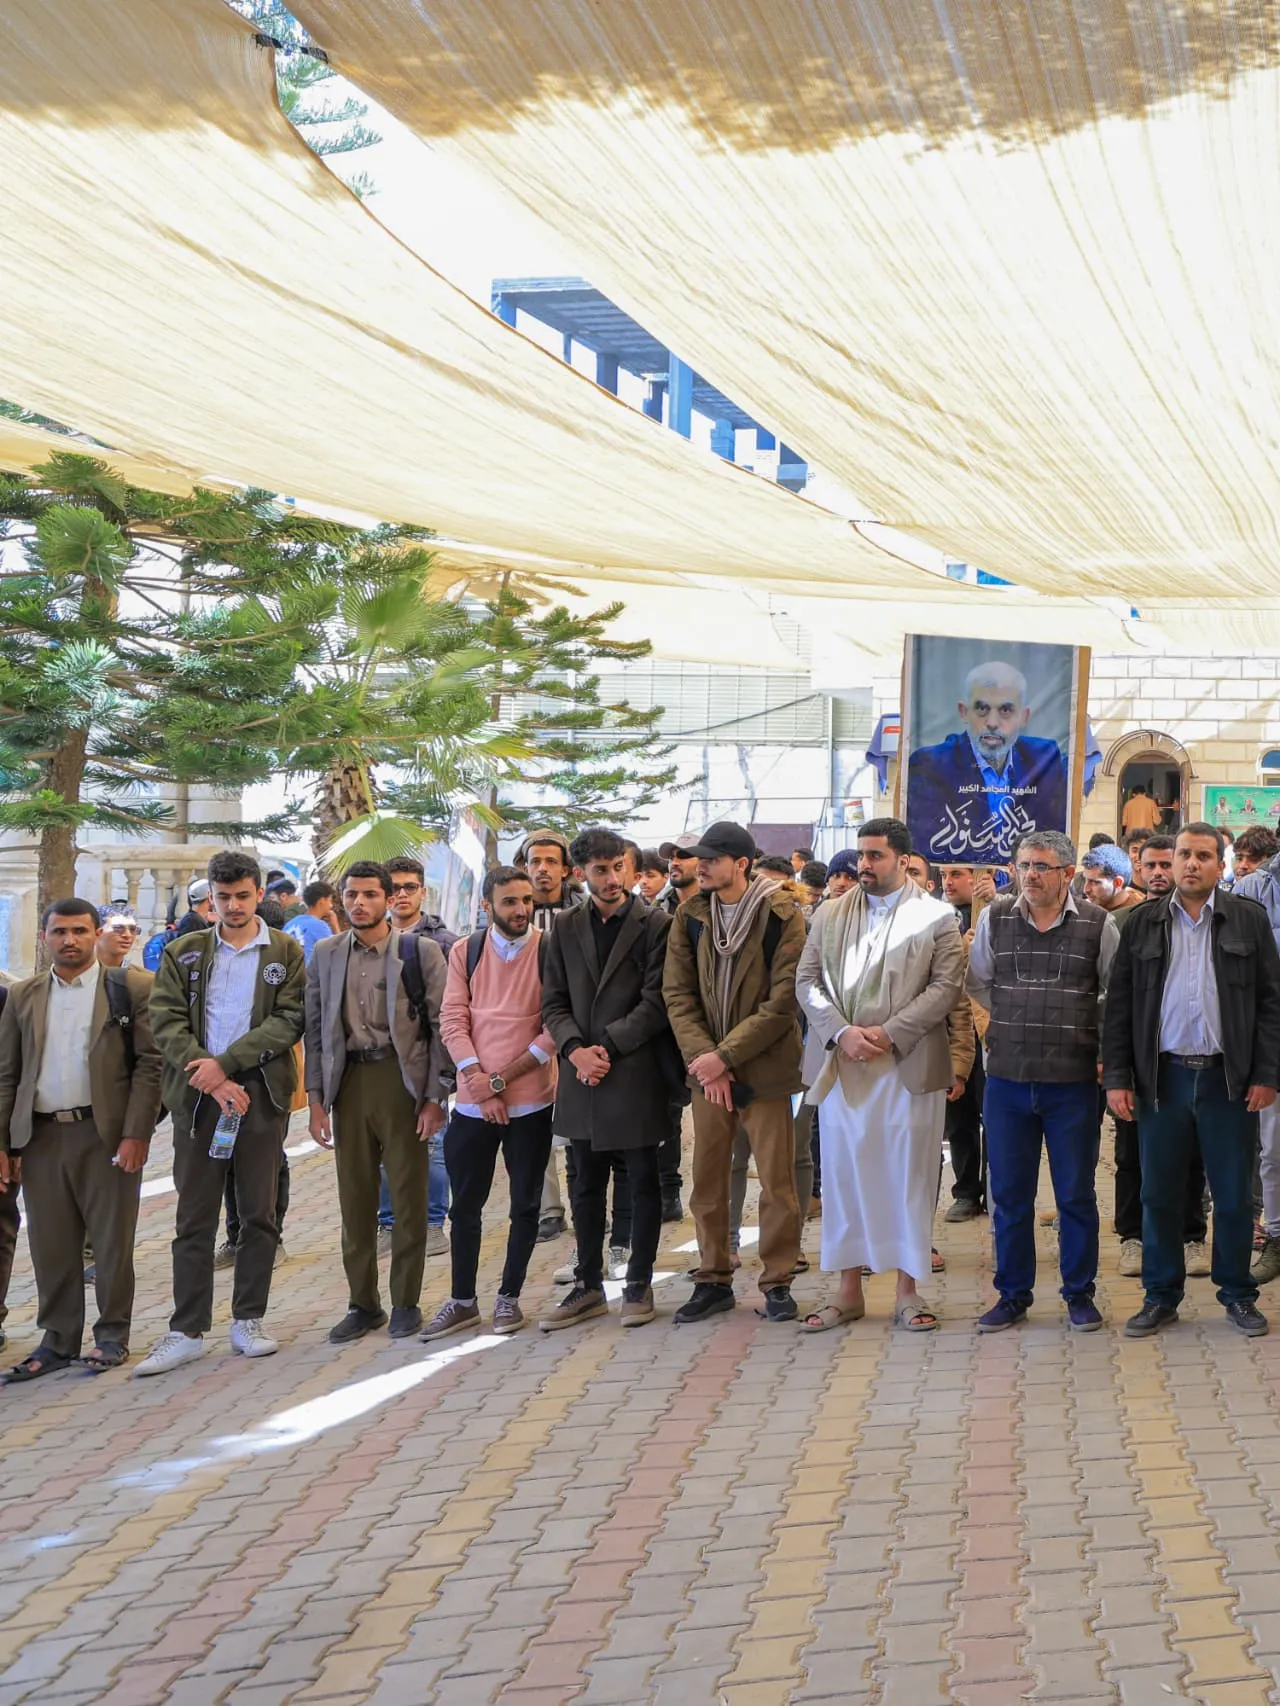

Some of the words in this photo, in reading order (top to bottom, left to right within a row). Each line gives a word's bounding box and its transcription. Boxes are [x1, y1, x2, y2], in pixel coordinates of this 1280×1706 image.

[958, 782, 979, 794] الكبير
[980, 784, 1010, 795] المجاهد
[1011, 785, 1037, 796] الشهيد
